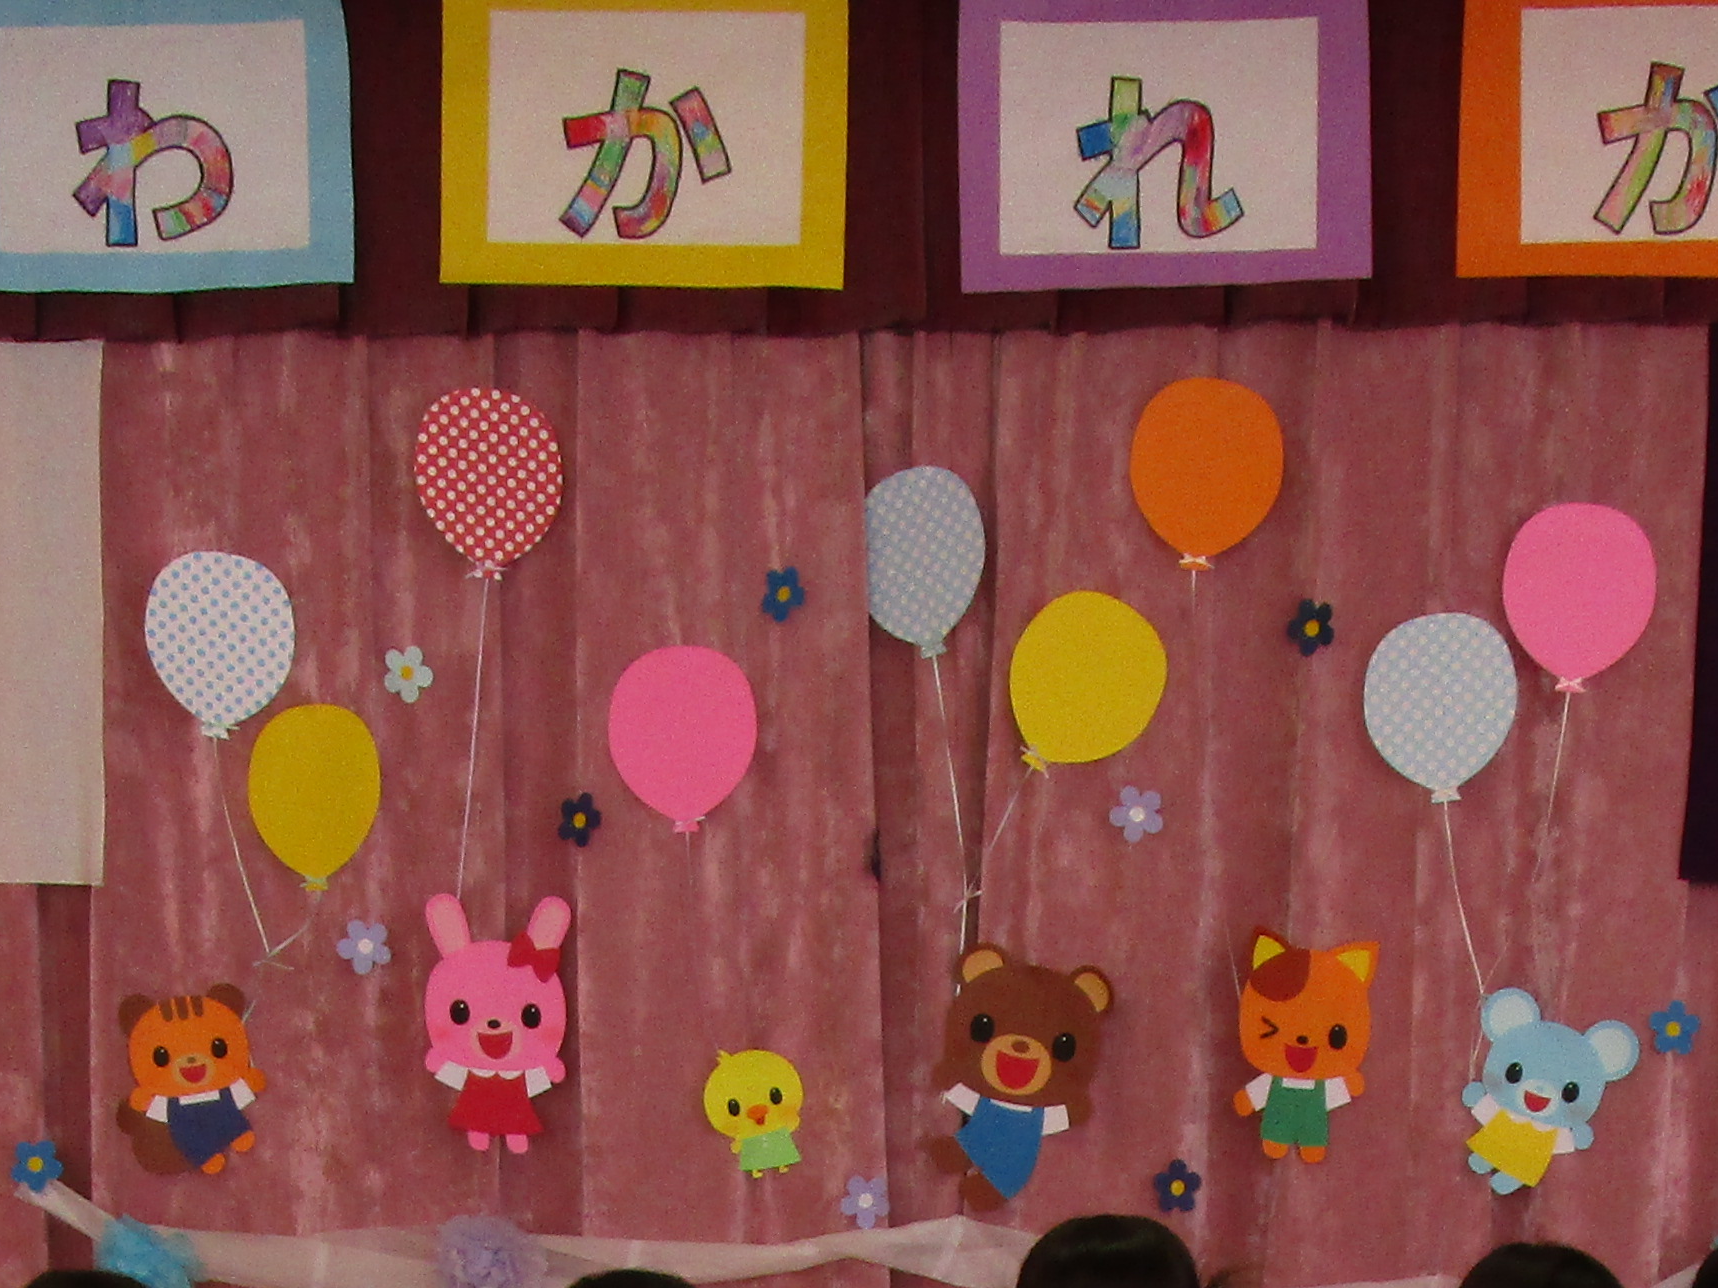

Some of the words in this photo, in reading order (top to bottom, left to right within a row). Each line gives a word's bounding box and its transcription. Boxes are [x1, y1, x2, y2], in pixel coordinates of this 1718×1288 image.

[72, 79, 234, 247] わ
[560, 68, 732, 239] か
[1073, 76, 1245, 249] れ
